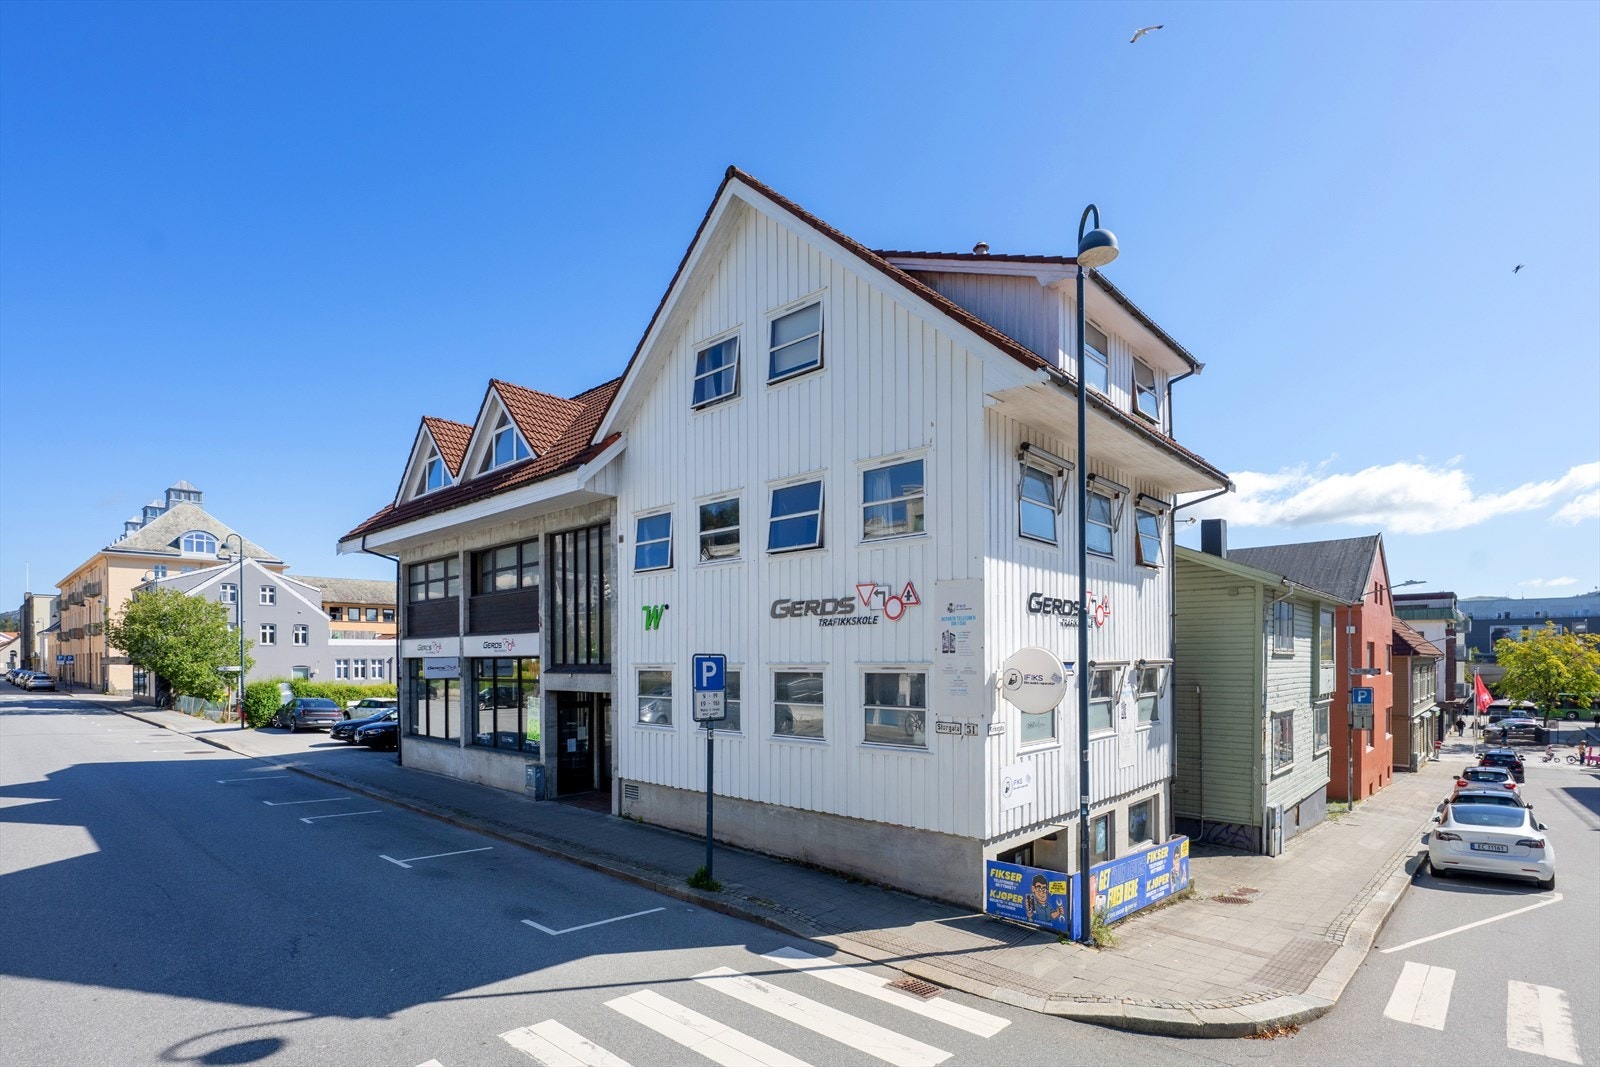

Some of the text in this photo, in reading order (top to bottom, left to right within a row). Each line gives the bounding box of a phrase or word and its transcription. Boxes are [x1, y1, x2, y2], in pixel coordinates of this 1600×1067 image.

[770, 597, 855, 618] GERDS
[1028, 592, 1080, 616] GERDS
[818, 616, 878, 627] TRAFIKKSKOLE
[702, 662, 716, 687] P
[1358, 691, 1367, 702] P
[937, 724, 975, 734] Storgata 51
[1147, 847, 1168, 864] FIKSER
[990, 868, 1022, 882] FIKSER
[1098, 868, 1111, 892] GET
[1147, 873, 1169, 891] KJØPER
[990, 889, 1023, 903] KJØPER
